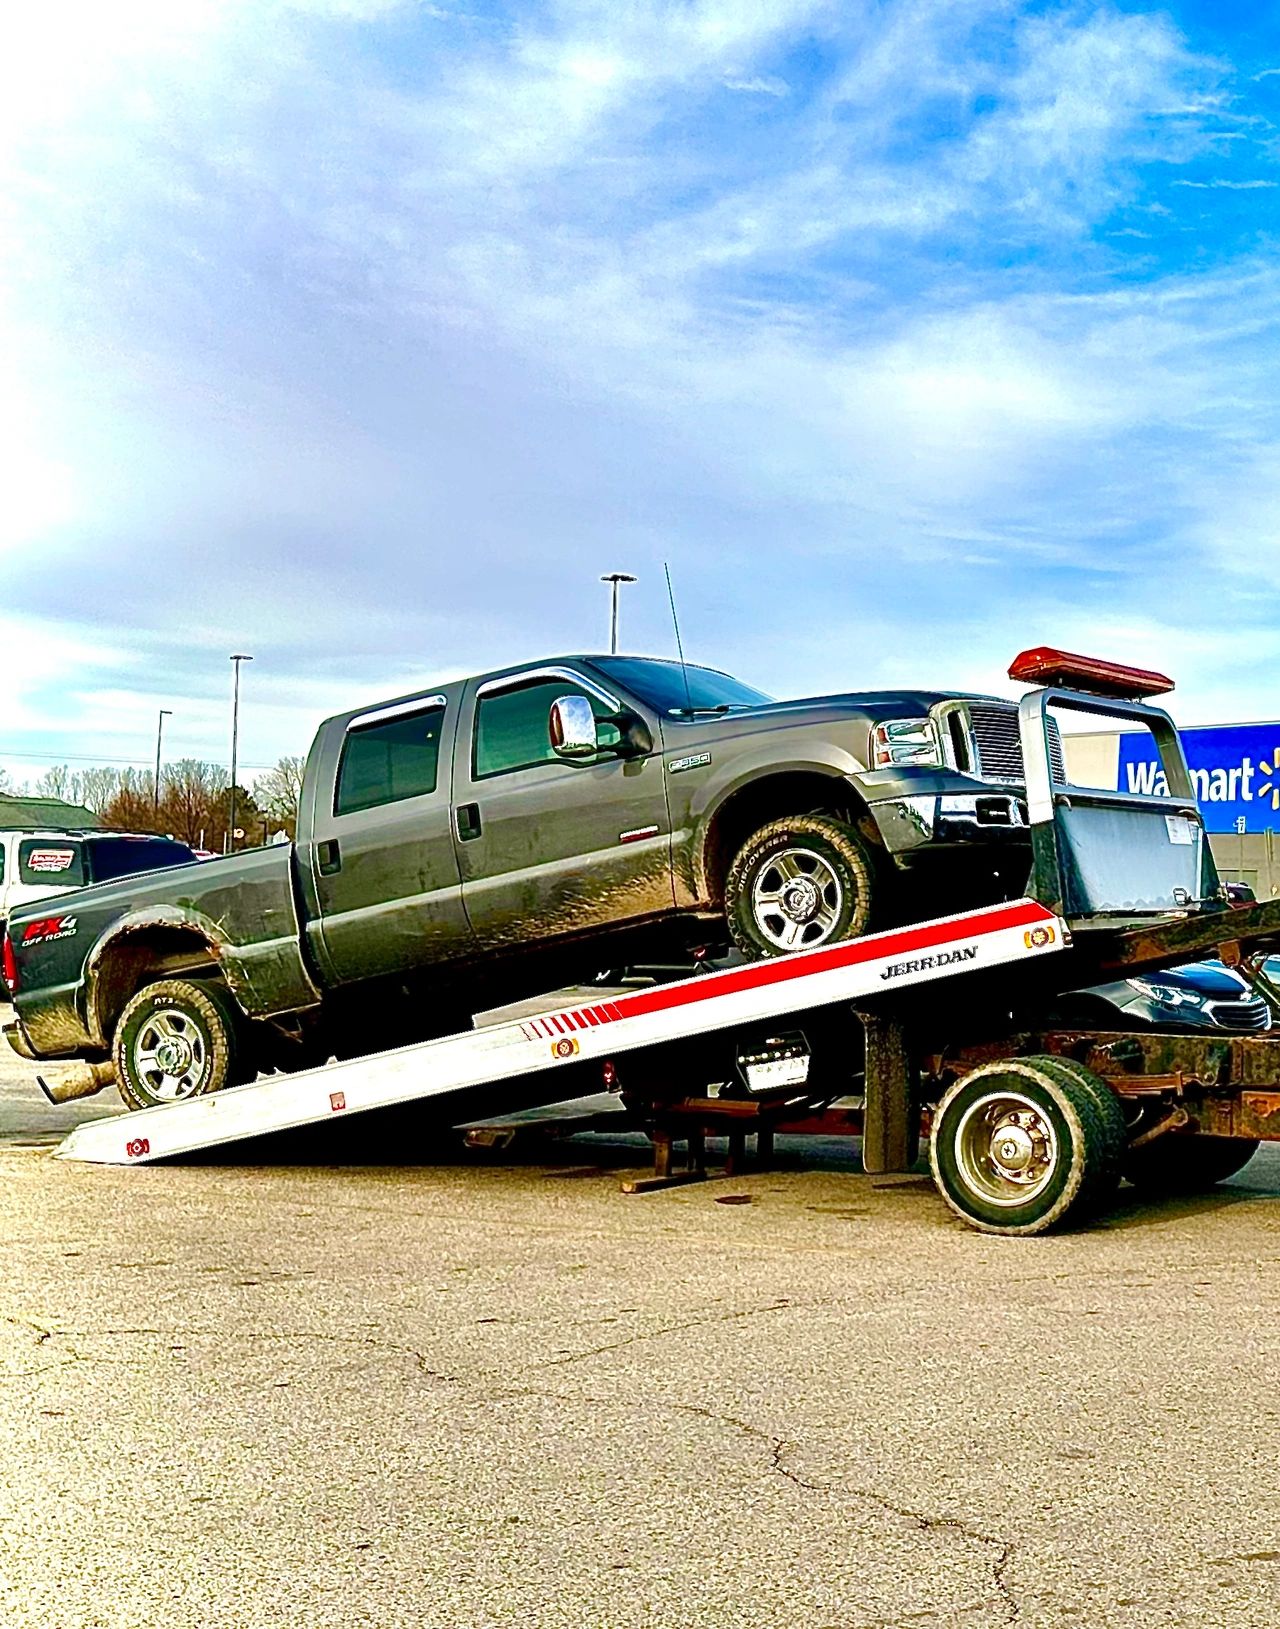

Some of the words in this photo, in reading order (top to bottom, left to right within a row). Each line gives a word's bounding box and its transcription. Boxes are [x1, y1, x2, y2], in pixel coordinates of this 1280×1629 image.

[1126, 757, 1255, 802] Wamart
[738, 834, 788, 892] DISCOVERER
[22, 936, 44, 948] OFF
[45, 928, 78, 942] ROAD
[23, 914, 78, 940] FX4
